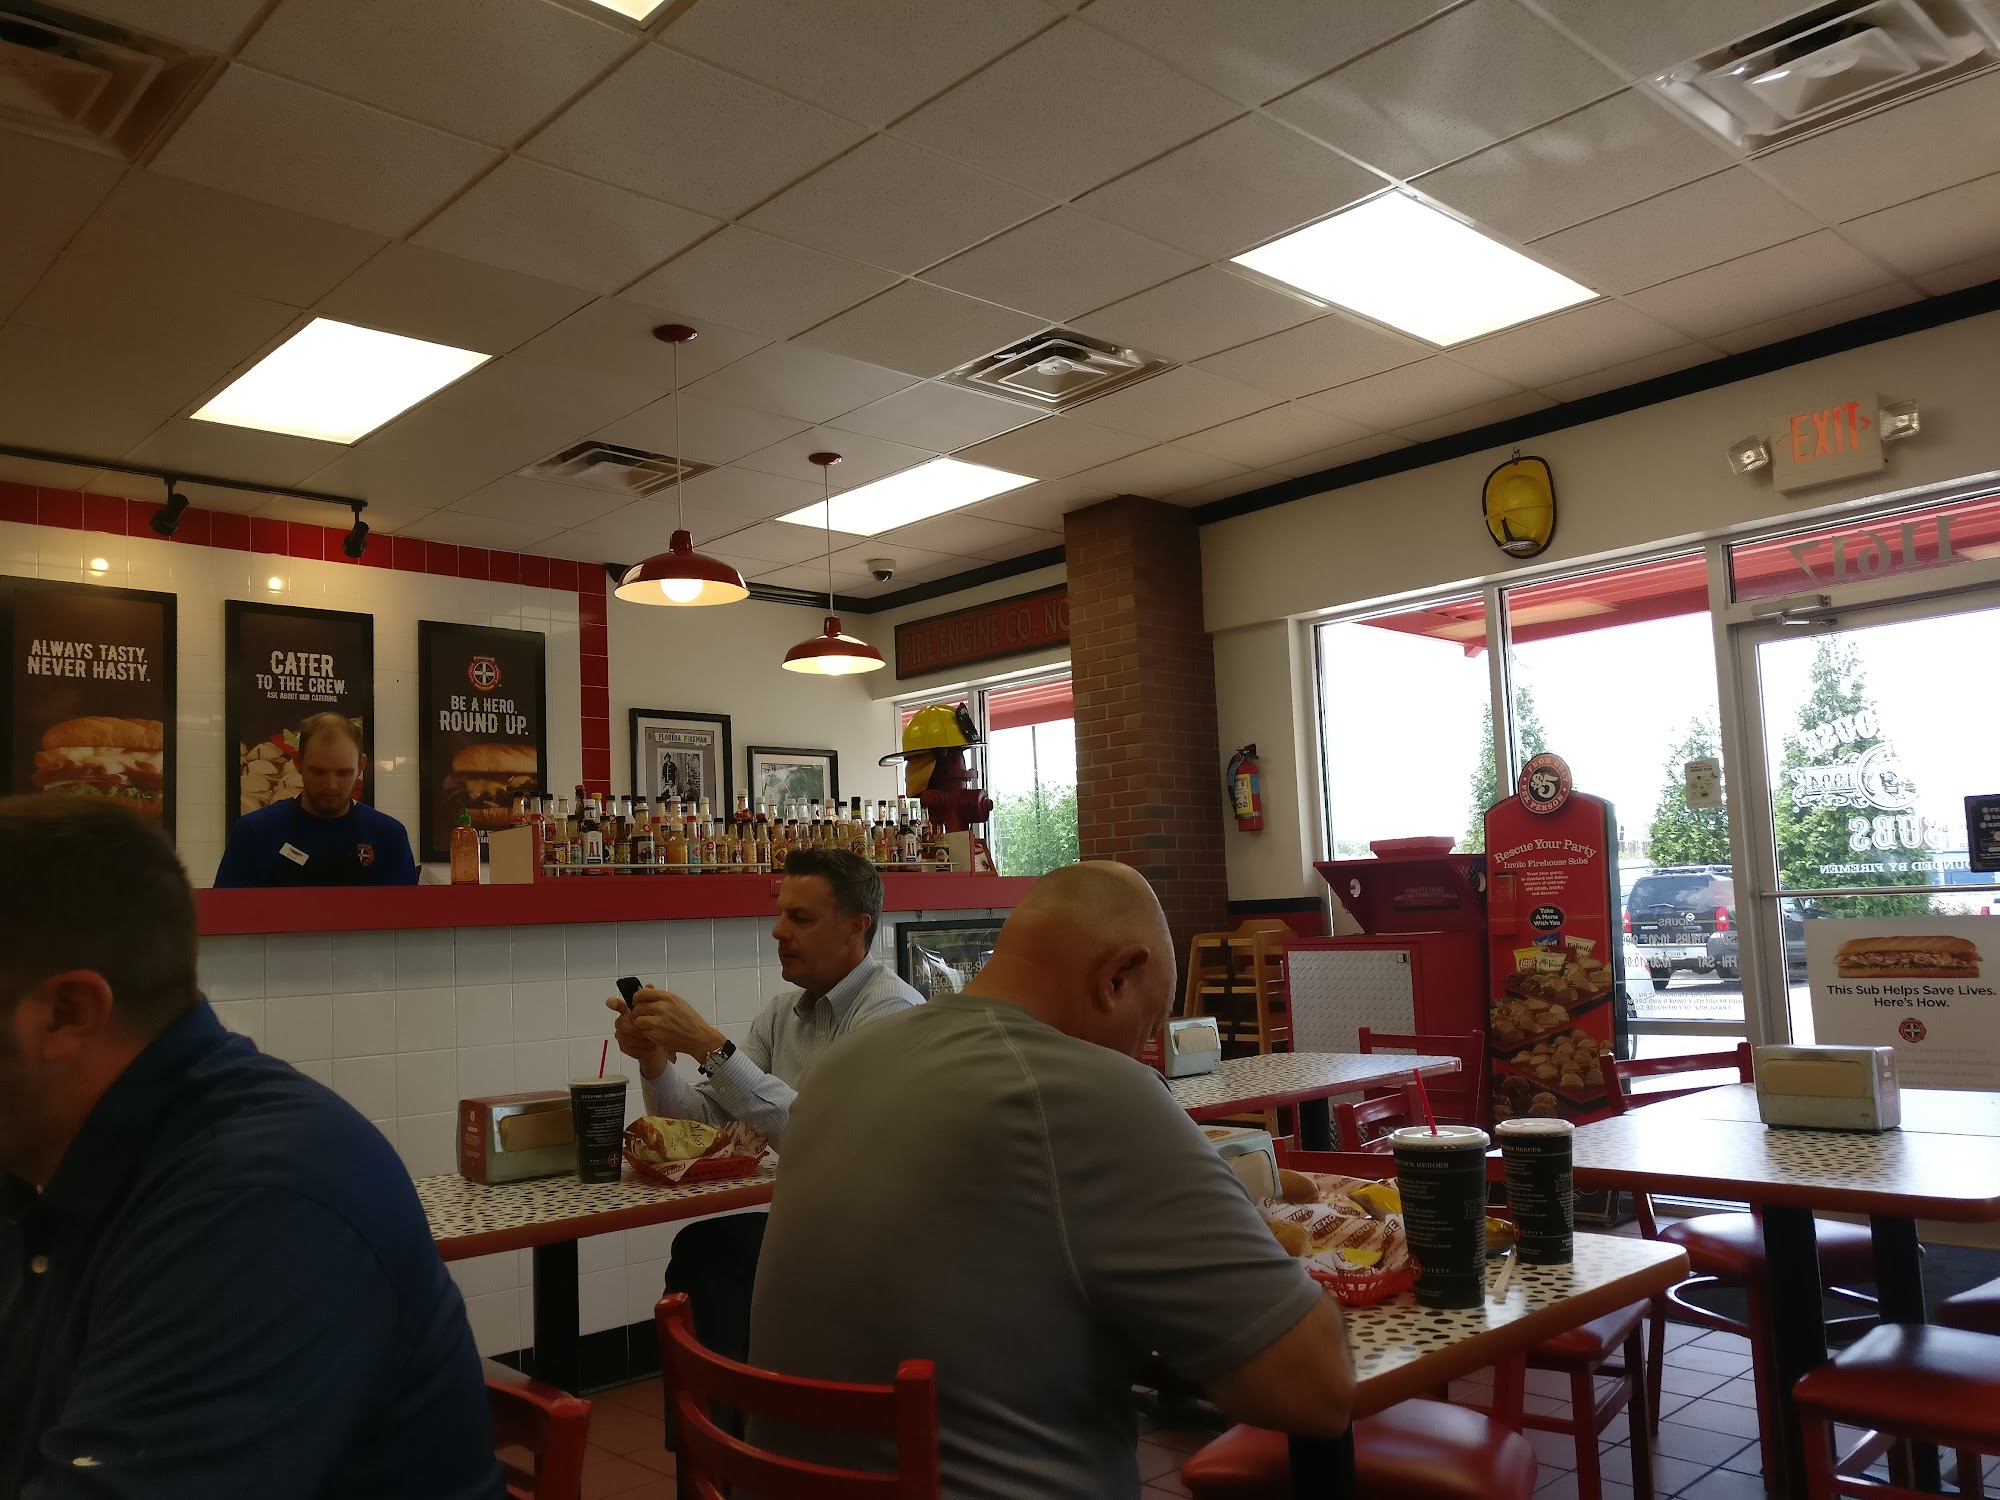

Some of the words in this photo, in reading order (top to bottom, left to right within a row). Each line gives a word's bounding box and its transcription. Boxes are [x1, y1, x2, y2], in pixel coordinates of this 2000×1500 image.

[1790, 401, 1860, 463] EXIT
[904, 629, 934, 668] FIRE
[940, 612, 1000, 660] ENGINE
[1005, 606, 1038, 644] CO.
[31, 639, 93, 660] ALWAYS
[99, 644, 148, 663] TASTY.
[27, 655, 87, 678] NEVER
[93, 660, 151, 682] HASTY.
[270, 650, 334, 678] CATER
[256, 673, 273, 690] TO
[278, 675, 304, 692] THE
[308, 677, 348, 695] CREW.
[267, 691, 278, 699] ASK
[280, 692, 298, 700] ABOUT
[299, 693, 311, 701] OUR
[451, 695, 467, 711] BE
[471, 696, 480, 712] A
[483, 697, 519, 714] HERO.
[439, 710, 499, 734] ROUND
[505, 714, 529, 735] UP.
[658, 733, 681, 742] FLORIDA
[684, 735, 709, 744] FIREMAN
[1528, 757, 1552, 772] FROM
[1530, 772, 1559, 799] $5
[1530, 794, 1564, 811] PERSON
[1493, 842, 1534, 864] Rescue
[1534, 838, 1562, 850] Your
[1563, 838, 1597, 859] Party
[1504, 861, 1527, 869] Invite
[1528, 859, 1567, 868] Firehouse
[1568, 857, 1589, 865] Subs
[1827, 985, 1852, 995] This
[1856, 985, 1880, 995] Sub
[1884, 985, 1920, 997] Helps
[1923, 986, 1955, 996] Save
[1959, 986, 1997, 996] Lives.
[1875, 997, 1914, 1007] Here's
[1917, 998, 1951, 1008] How.
[1416, 1161, 1450, 1170] HEROES
